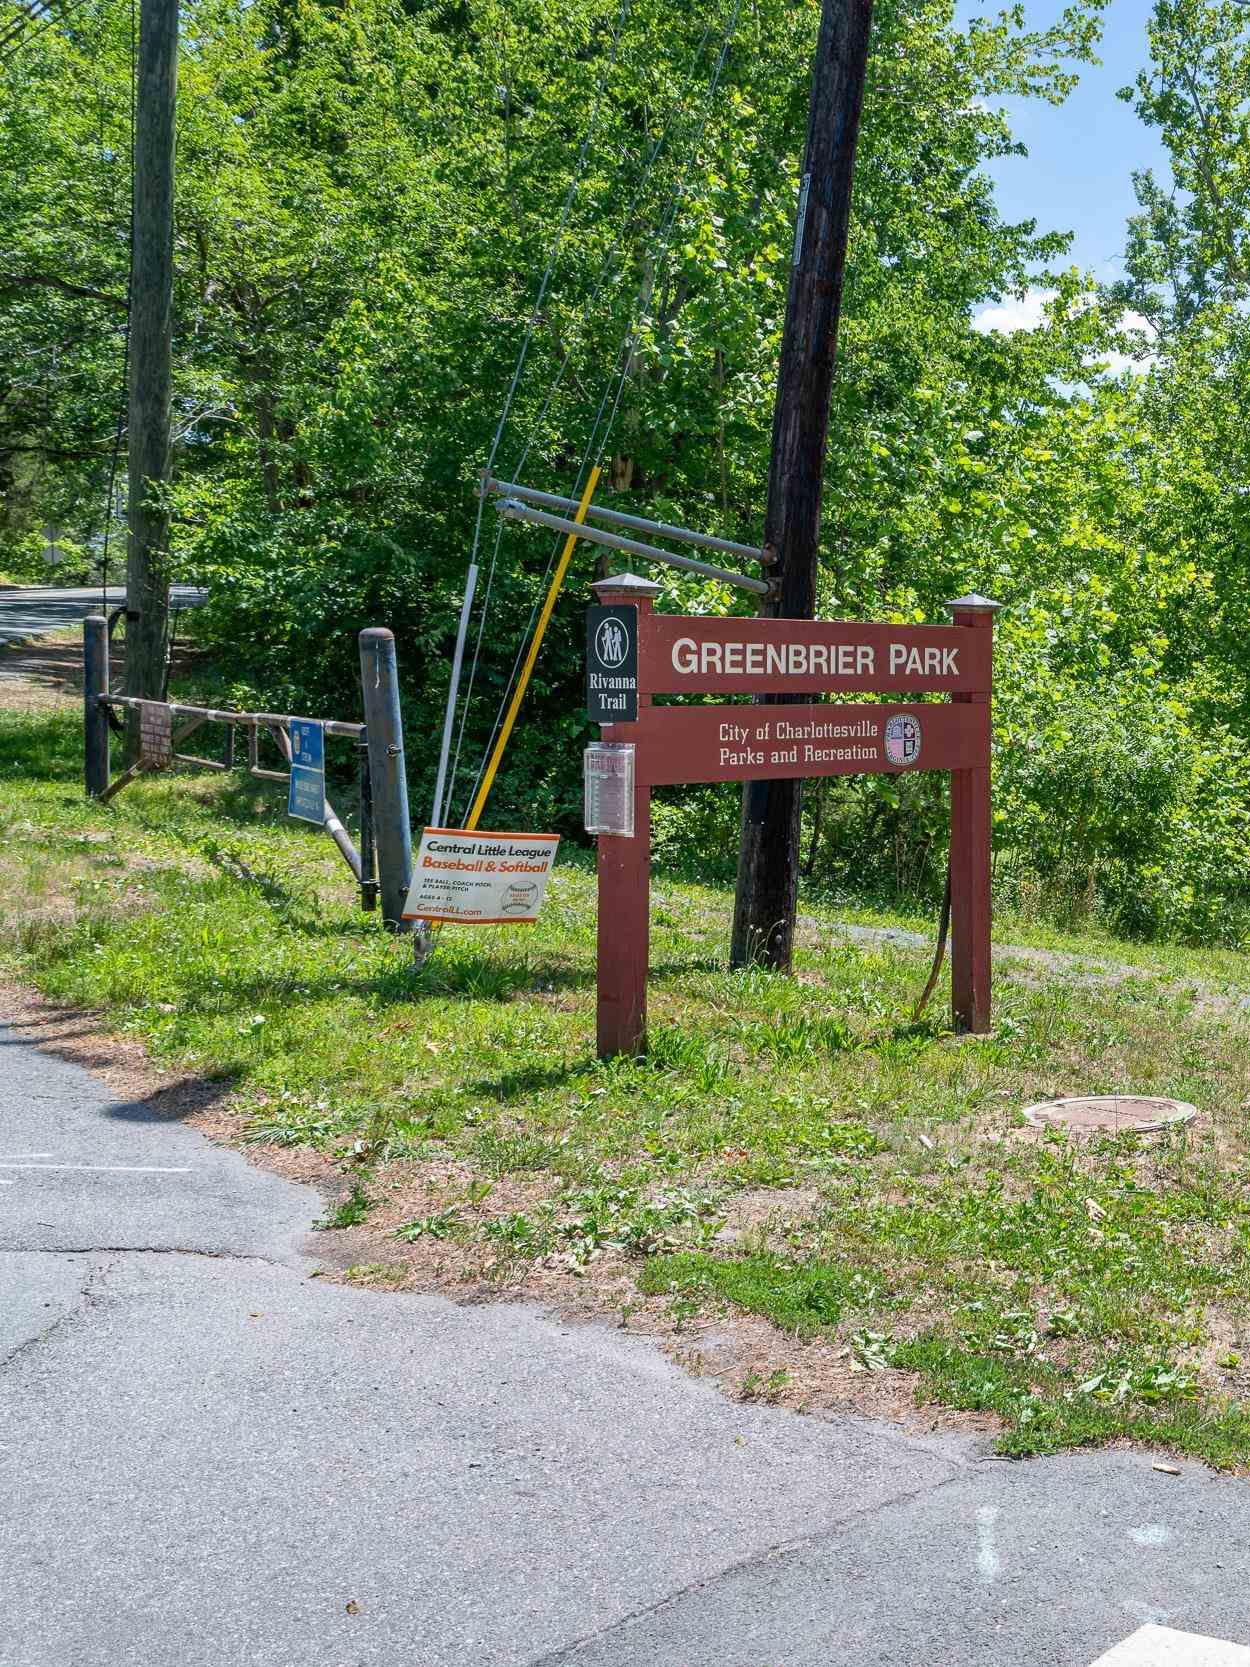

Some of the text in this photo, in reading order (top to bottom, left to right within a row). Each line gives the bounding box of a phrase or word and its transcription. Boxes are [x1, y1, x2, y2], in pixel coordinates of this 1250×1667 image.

[671, 637, 960, 676] GREENBRIER PARK
[589, 673, 637, 690] Rivanna
[599, 693, 627, 710] Trail
[719, 721, 878, 744] City of Charlottesville
[719, 744, 878, 766] Parks and Recreation
[427, 841, 551, 859] Central Little League
[422, 856, 548, 873] Baseball & Softball
